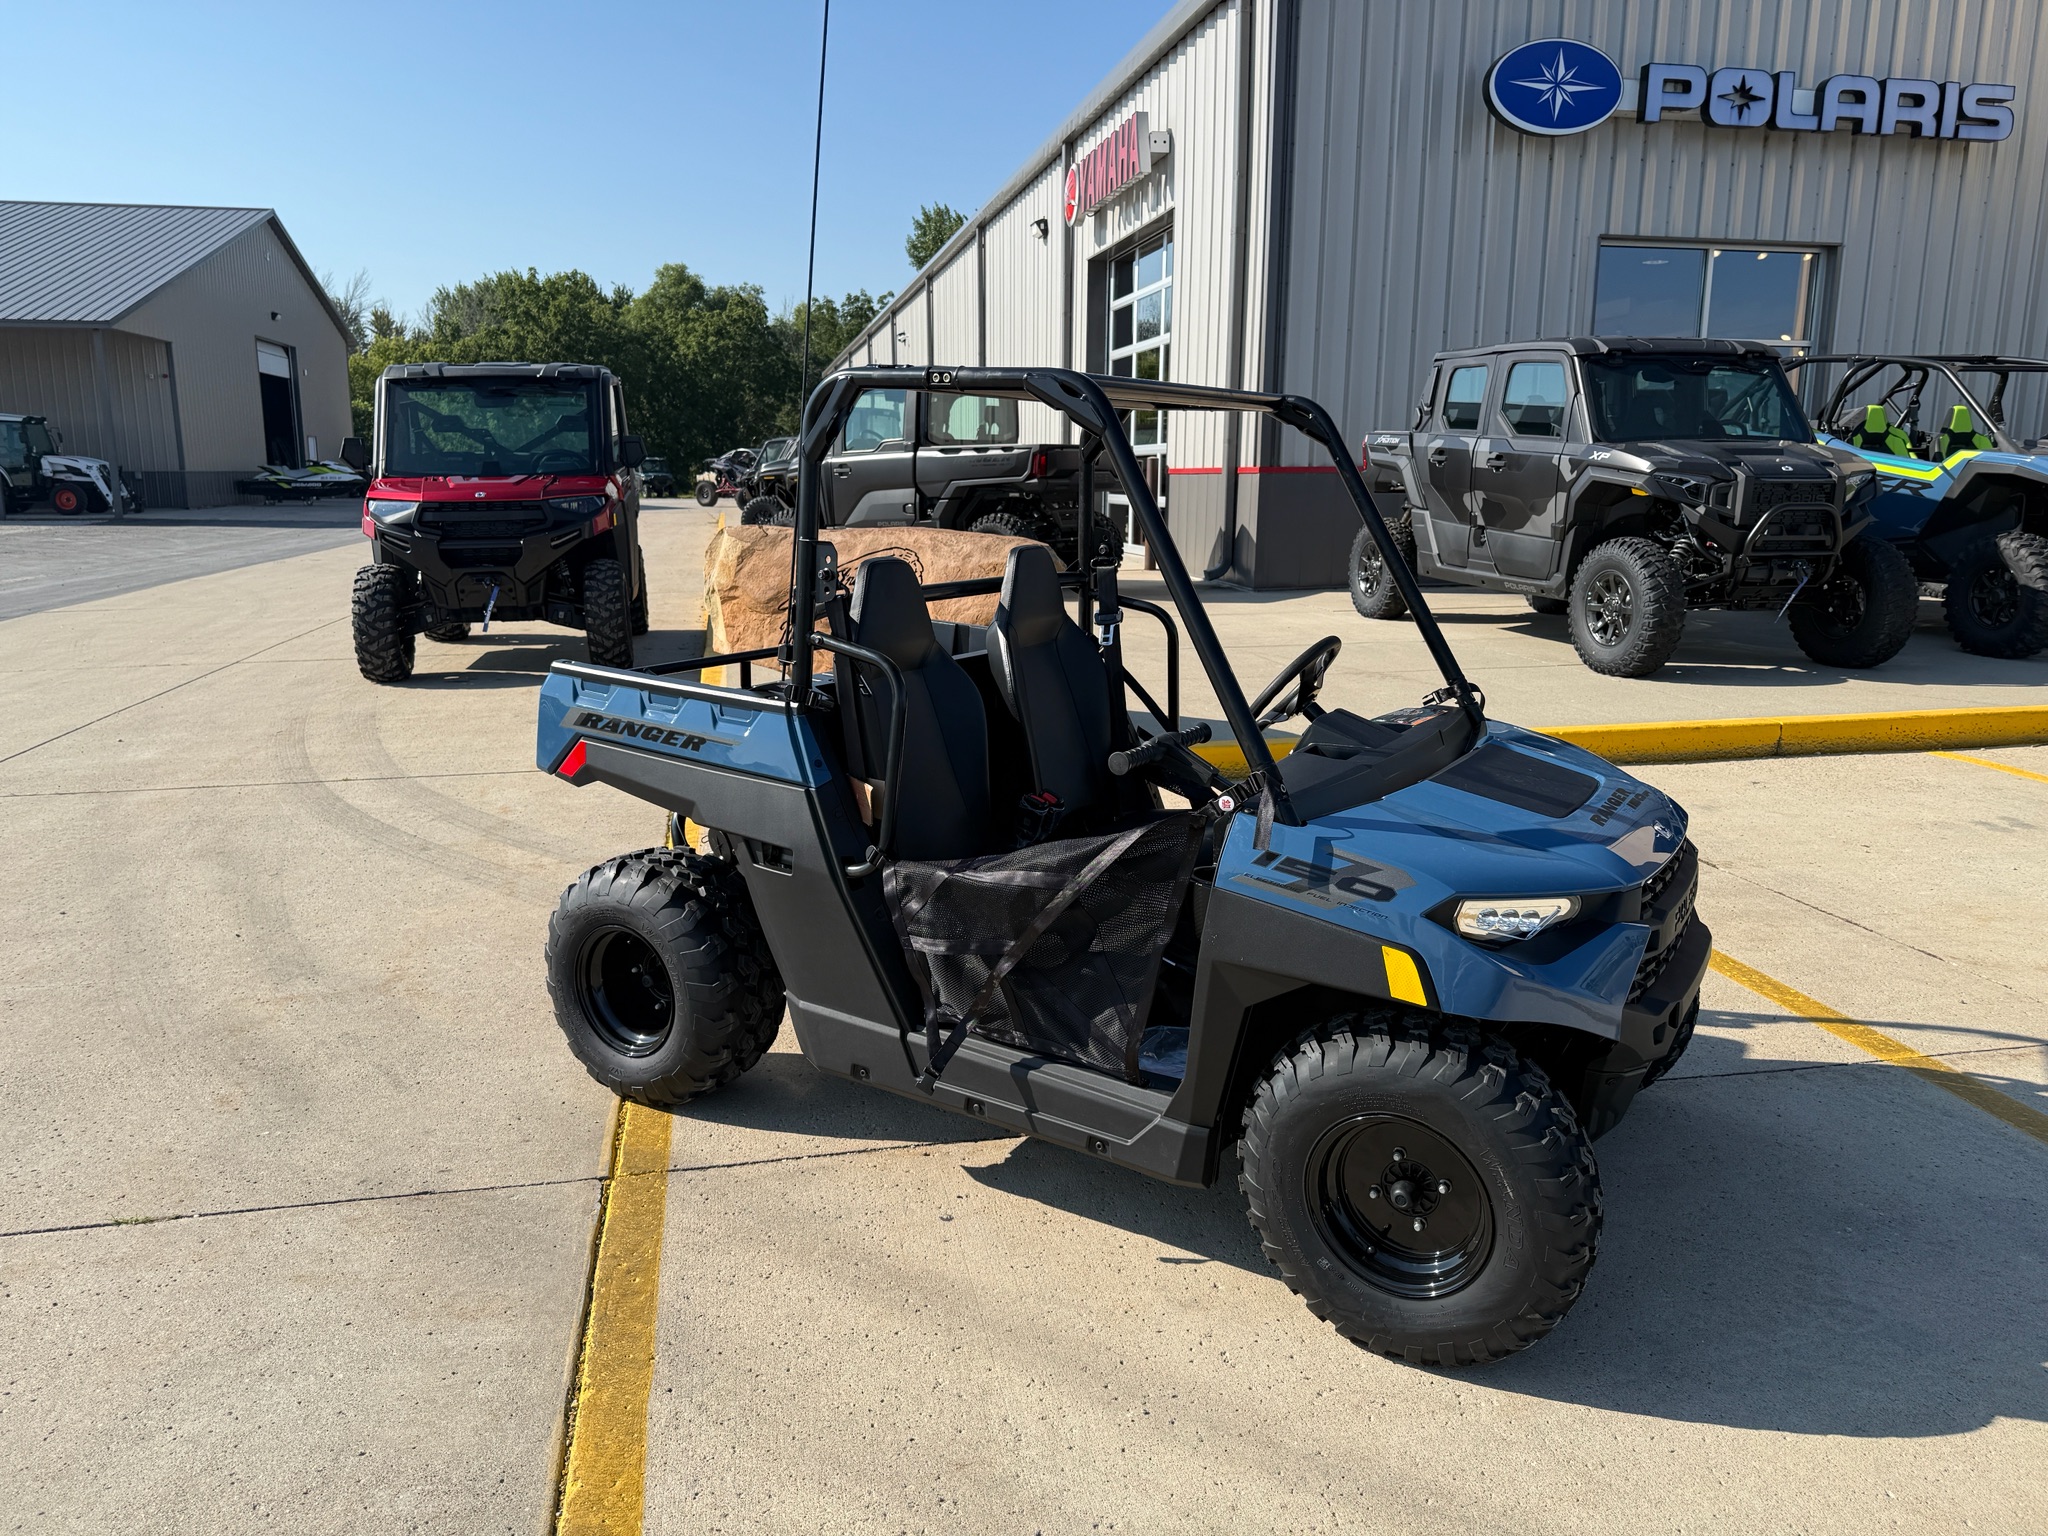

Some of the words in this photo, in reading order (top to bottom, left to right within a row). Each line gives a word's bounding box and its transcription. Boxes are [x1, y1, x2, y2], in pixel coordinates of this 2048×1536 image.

[1639, 62, 2016, 141] POLARIS
[1079, 112, 1140, 214] YAMAHA
[1588, 450, 1612, 461] XP
[1503, 581, 1537, 593] POLARIS
[576, 712, 707, 753] RANGER
[1589, 787, 1633, 828] RANGER
[1243, 872, 1301, 894] ELECTRONIC
[1306, 891, 1332, 903] FUEL
[1336, 900, 1389, 921] INJECTION
